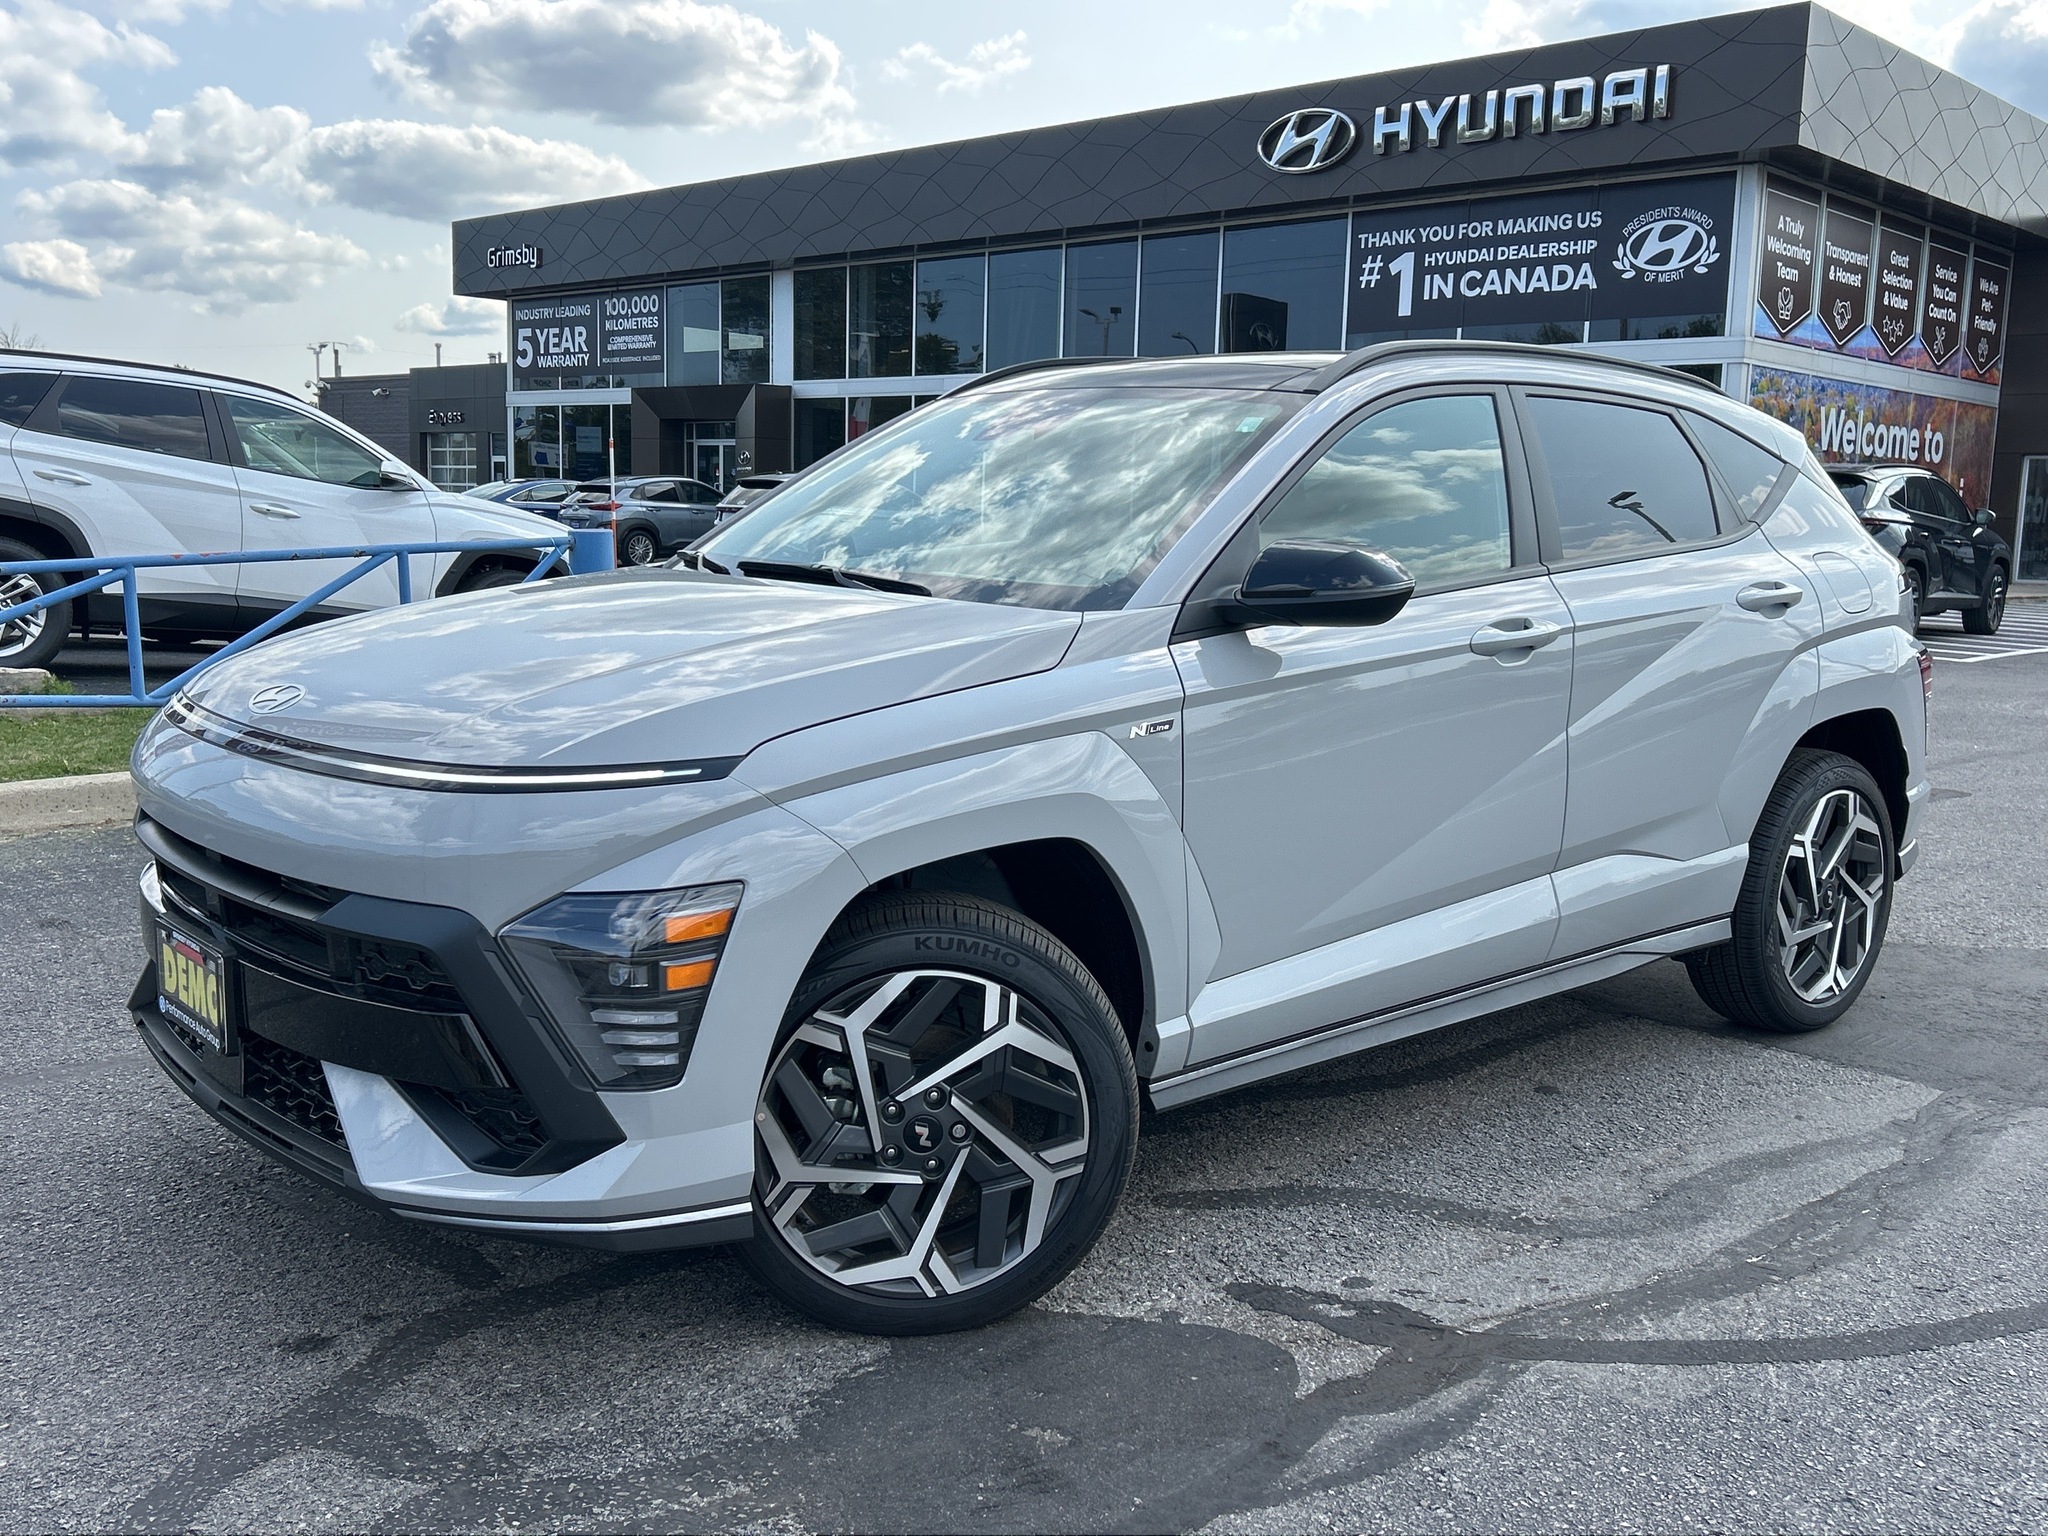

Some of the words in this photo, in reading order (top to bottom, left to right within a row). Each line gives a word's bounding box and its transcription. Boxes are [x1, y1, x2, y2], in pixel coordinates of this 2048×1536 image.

[1373, 63, 1671, 155] HYUNDAI
[1358, 228, 1416, 249] THANK
[1419, 224, 1455, 243] YOU
[1458, 221, 1494, 240] FOR
[1497, 213, 1573, 236] MAKING
[1577, 210, 1602, 229] US
[1622, 206, 1680, 238] PRESIDENT'S
[1681, 207, 1714, 230] AWARD
[1777, 214, 1785, 231] A
[1785, 216, 1805, 240] Truly
[487, 243, 537, 268] Grimsby
[1424, 246, 1495, 267] HYUNDAI
[1497, 239, 1598, 260] DEALERSHIP
[1767, 234, 1811, 266] Welcoming
[1826, 241, 1869, 268] Transparent
[1890, 250, 1910, 268] Great
[1424, 272, 1454, 300] IN
[1460, 262, 1598, 298] CANADA
[1644, 272, 1657, 283] OF
[1658, 269, 1685, 283] MERIT
[1776, 261, 1799, 282] Team
[1829, 265, 1836, 281] &
[1836, 266, 1862, 288] Honest
[1882, 269, 1913, 291] Selection
[1935, 264, 1958, 283] Service
[1932, 283, 1944, 300] You
[1944, 287, 1957, 303] Can
[1979, 277, 1989, 292] We
[1989, 281, 1999, 296] Are
[515, 307, 554, 321] INDUSTRY
[555, 304, 591, 318] LEADING
[604, 294, 659, 317] 100,000
[1883, 291, 1889, 306] &
[1890, 292, 1909, 311] Value
[605, 316, 659, 331] KILOMETRES
[1929, 303, 1947, 321] Count
[1947, 308, 1957, 323] On
[1974, 315, 1997, 335] Friendly
[516, 328, 533, 368] 5
[535, 325, 588, 354] YEAR
[537, 353, 590, 368] WARRANTY
[1820, 405, 1920, 461] Welcome
[1924, 423, 1944, 464] to
[914, 936, 1020, 968] KUMHO
[166, 1000, 196, 1030] Performance
